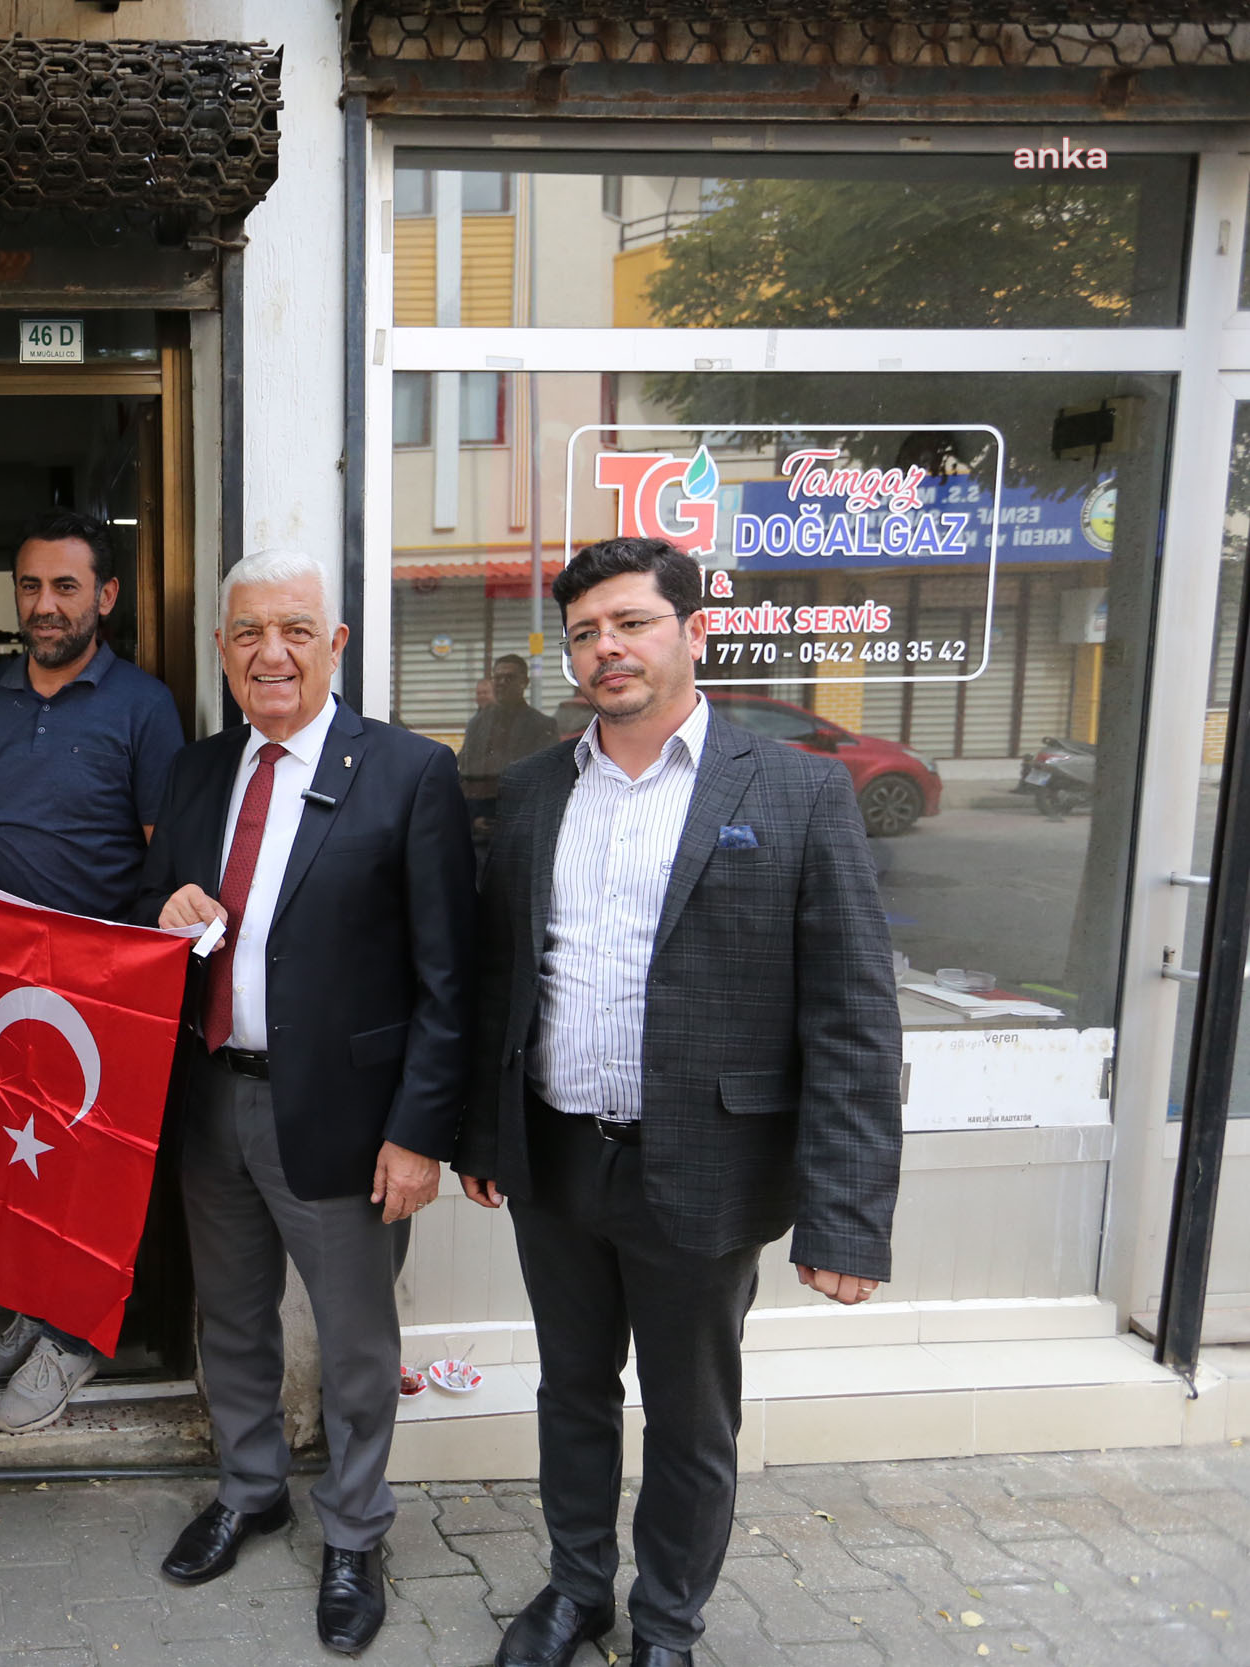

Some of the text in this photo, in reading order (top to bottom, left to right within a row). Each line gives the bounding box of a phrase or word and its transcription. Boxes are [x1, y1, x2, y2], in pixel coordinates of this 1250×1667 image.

[29, 325, 74, 346] 46 D
[782, 447, 926, 512] Tamgaz
[732, 504, 969, 557] DOĞALGAZ
[710, 570, 733, 598] &
[703, 600, 891, 634] EKNİK SERVİS
[716, 643, 743, 664] 77
[750, 643, 777, 664] 70
[800, 642, 854, 663] 0542
[859, 641, 900, 663] 488
[906, 641, 933, 661] 35
[938, 640, 966, 661] 42
